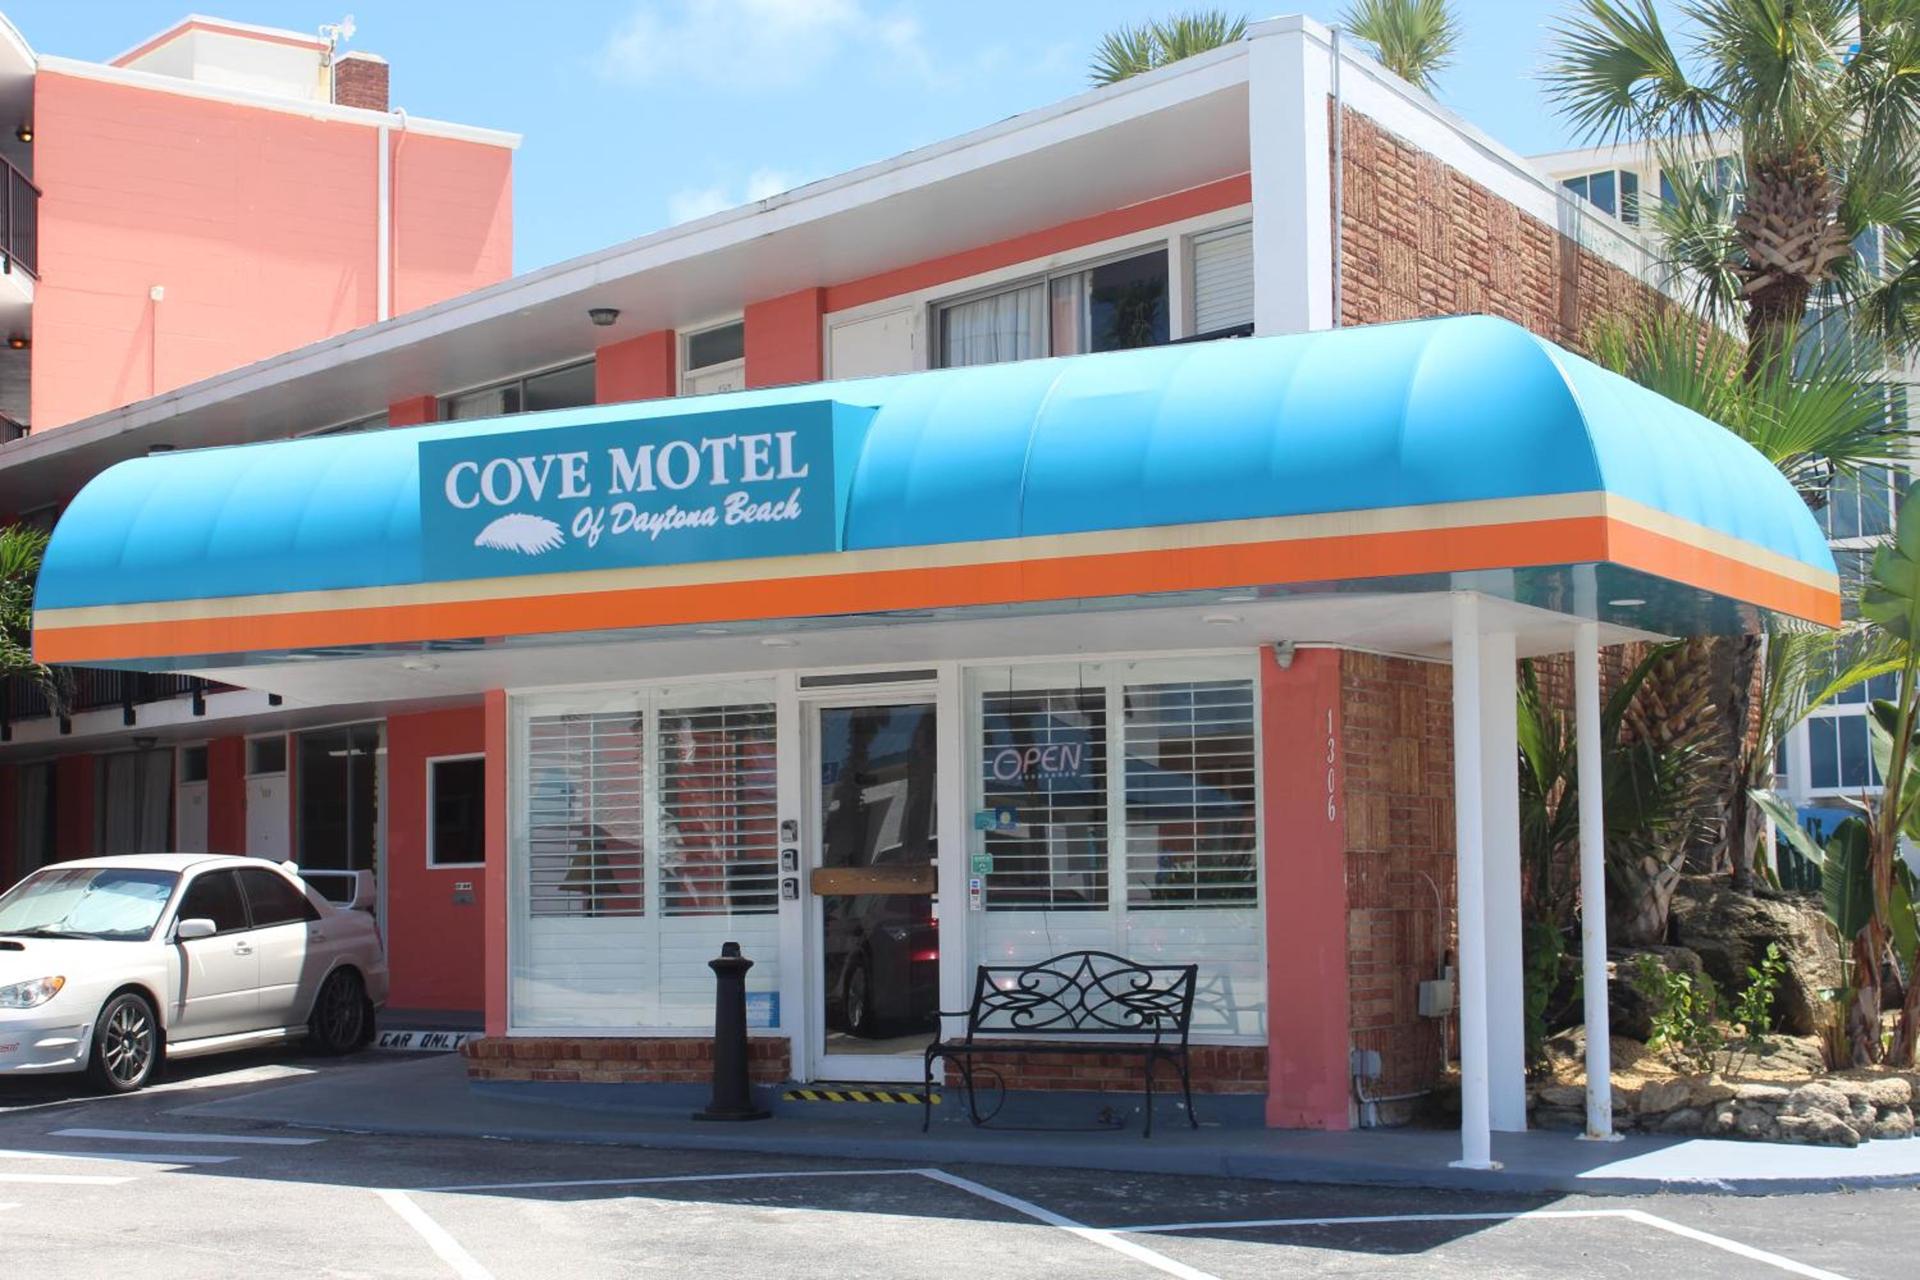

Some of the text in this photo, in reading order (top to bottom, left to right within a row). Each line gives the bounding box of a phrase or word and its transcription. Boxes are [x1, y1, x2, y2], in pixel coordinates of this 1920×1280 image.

[446, 430, 808, 509] COVE MOTEL
[571, 487, 801, 547] Of Daytona Beach
[993, 743, 1082, 780] OPEN
[1327, 708, 1336, 822] 1306
[380, 1033, 465, 1050] CAR ONLY
